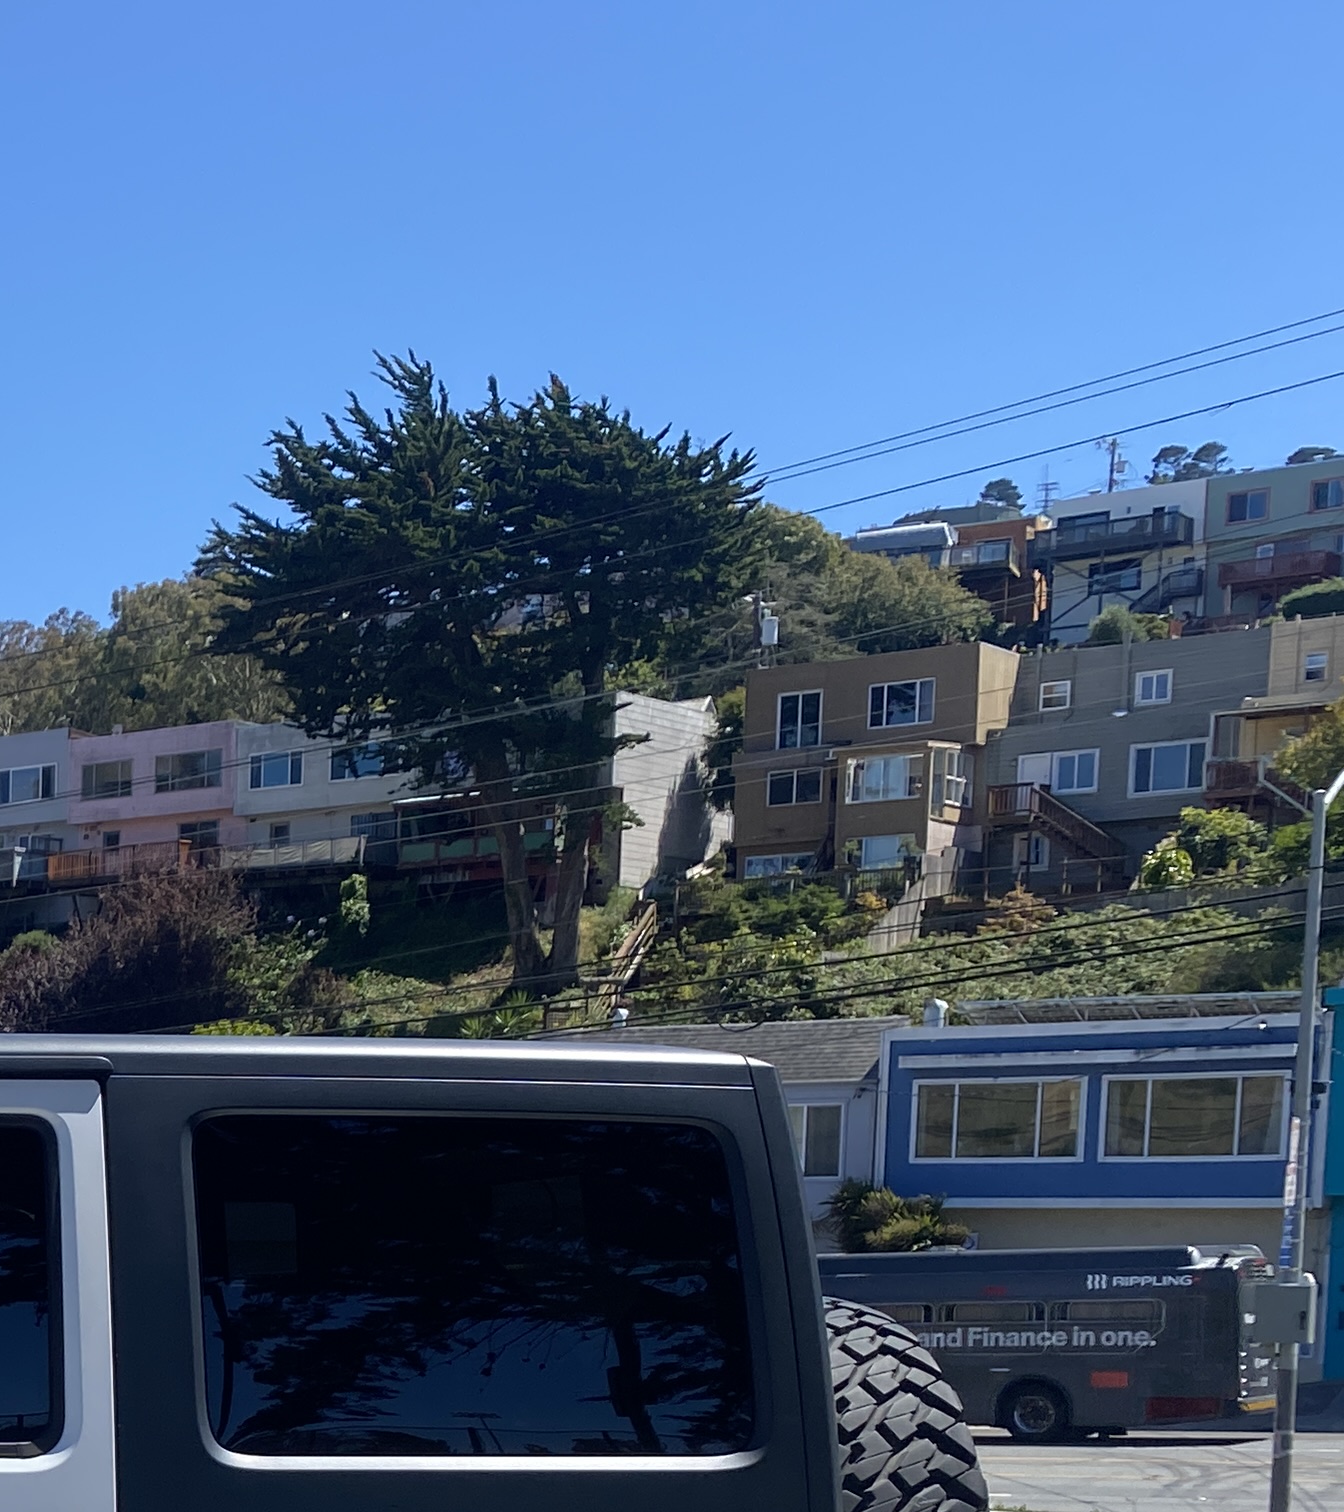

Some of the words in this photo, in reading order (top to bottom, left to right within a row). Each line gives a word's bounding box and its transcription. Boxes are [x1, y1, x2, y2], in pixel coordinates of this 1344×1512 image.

[1112, 1274, 1193, 1287] RIPPLING
[916, 1327, 962, 1348] and
[967, 1326, 1069, 1348] Finance
[1072, 1326, 1097, 1347] in
[1100, 1329, 1157, 1348] one.
